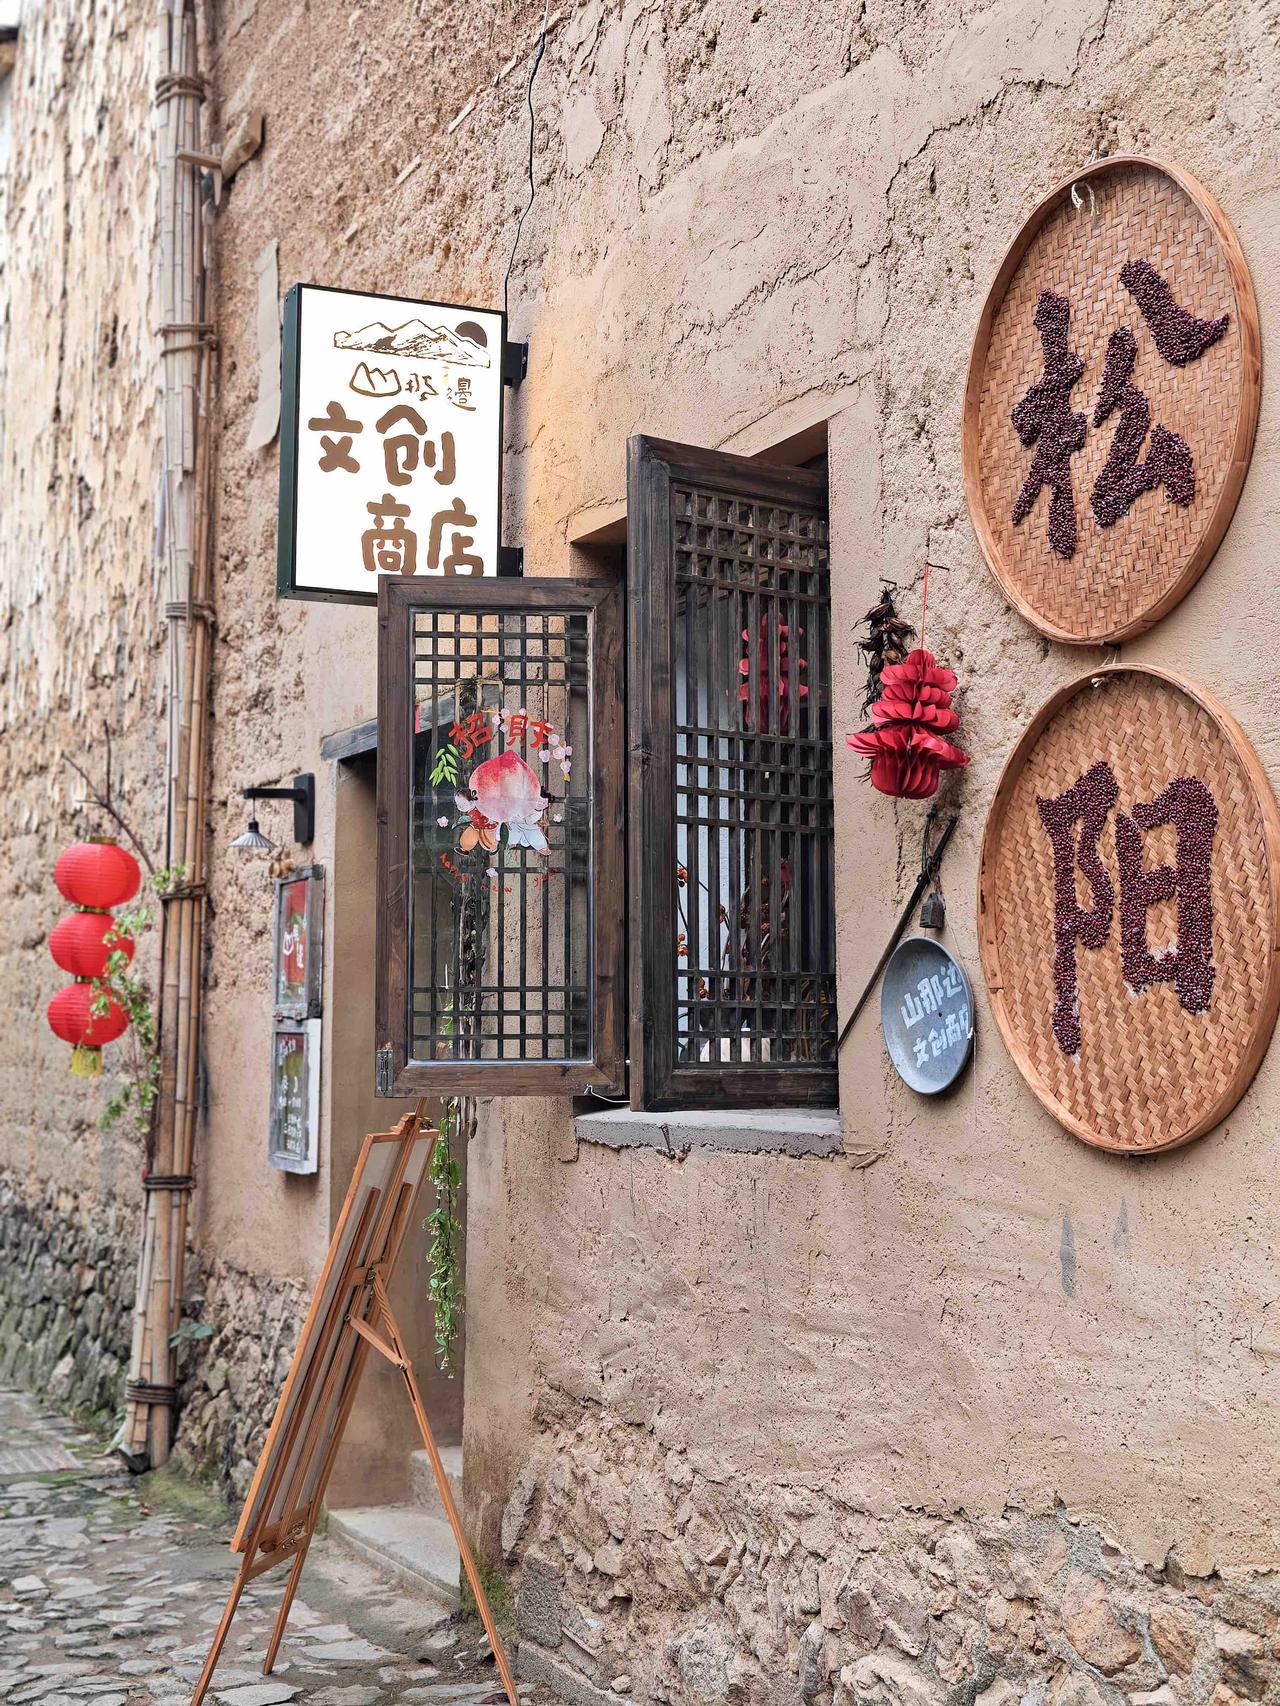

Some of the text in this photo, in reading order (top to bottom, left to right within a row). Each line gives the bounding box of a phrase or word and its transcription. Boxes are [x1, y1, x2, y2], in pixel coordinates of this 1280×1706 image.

[308, 401, 456, 486] 文创
[1011, 258, 1230, 559] 松
[361, 493, 484, 576] 商店
[1036, 761, 1219, 1059] 阳
[900, 961, 963, 1030] 山那边
